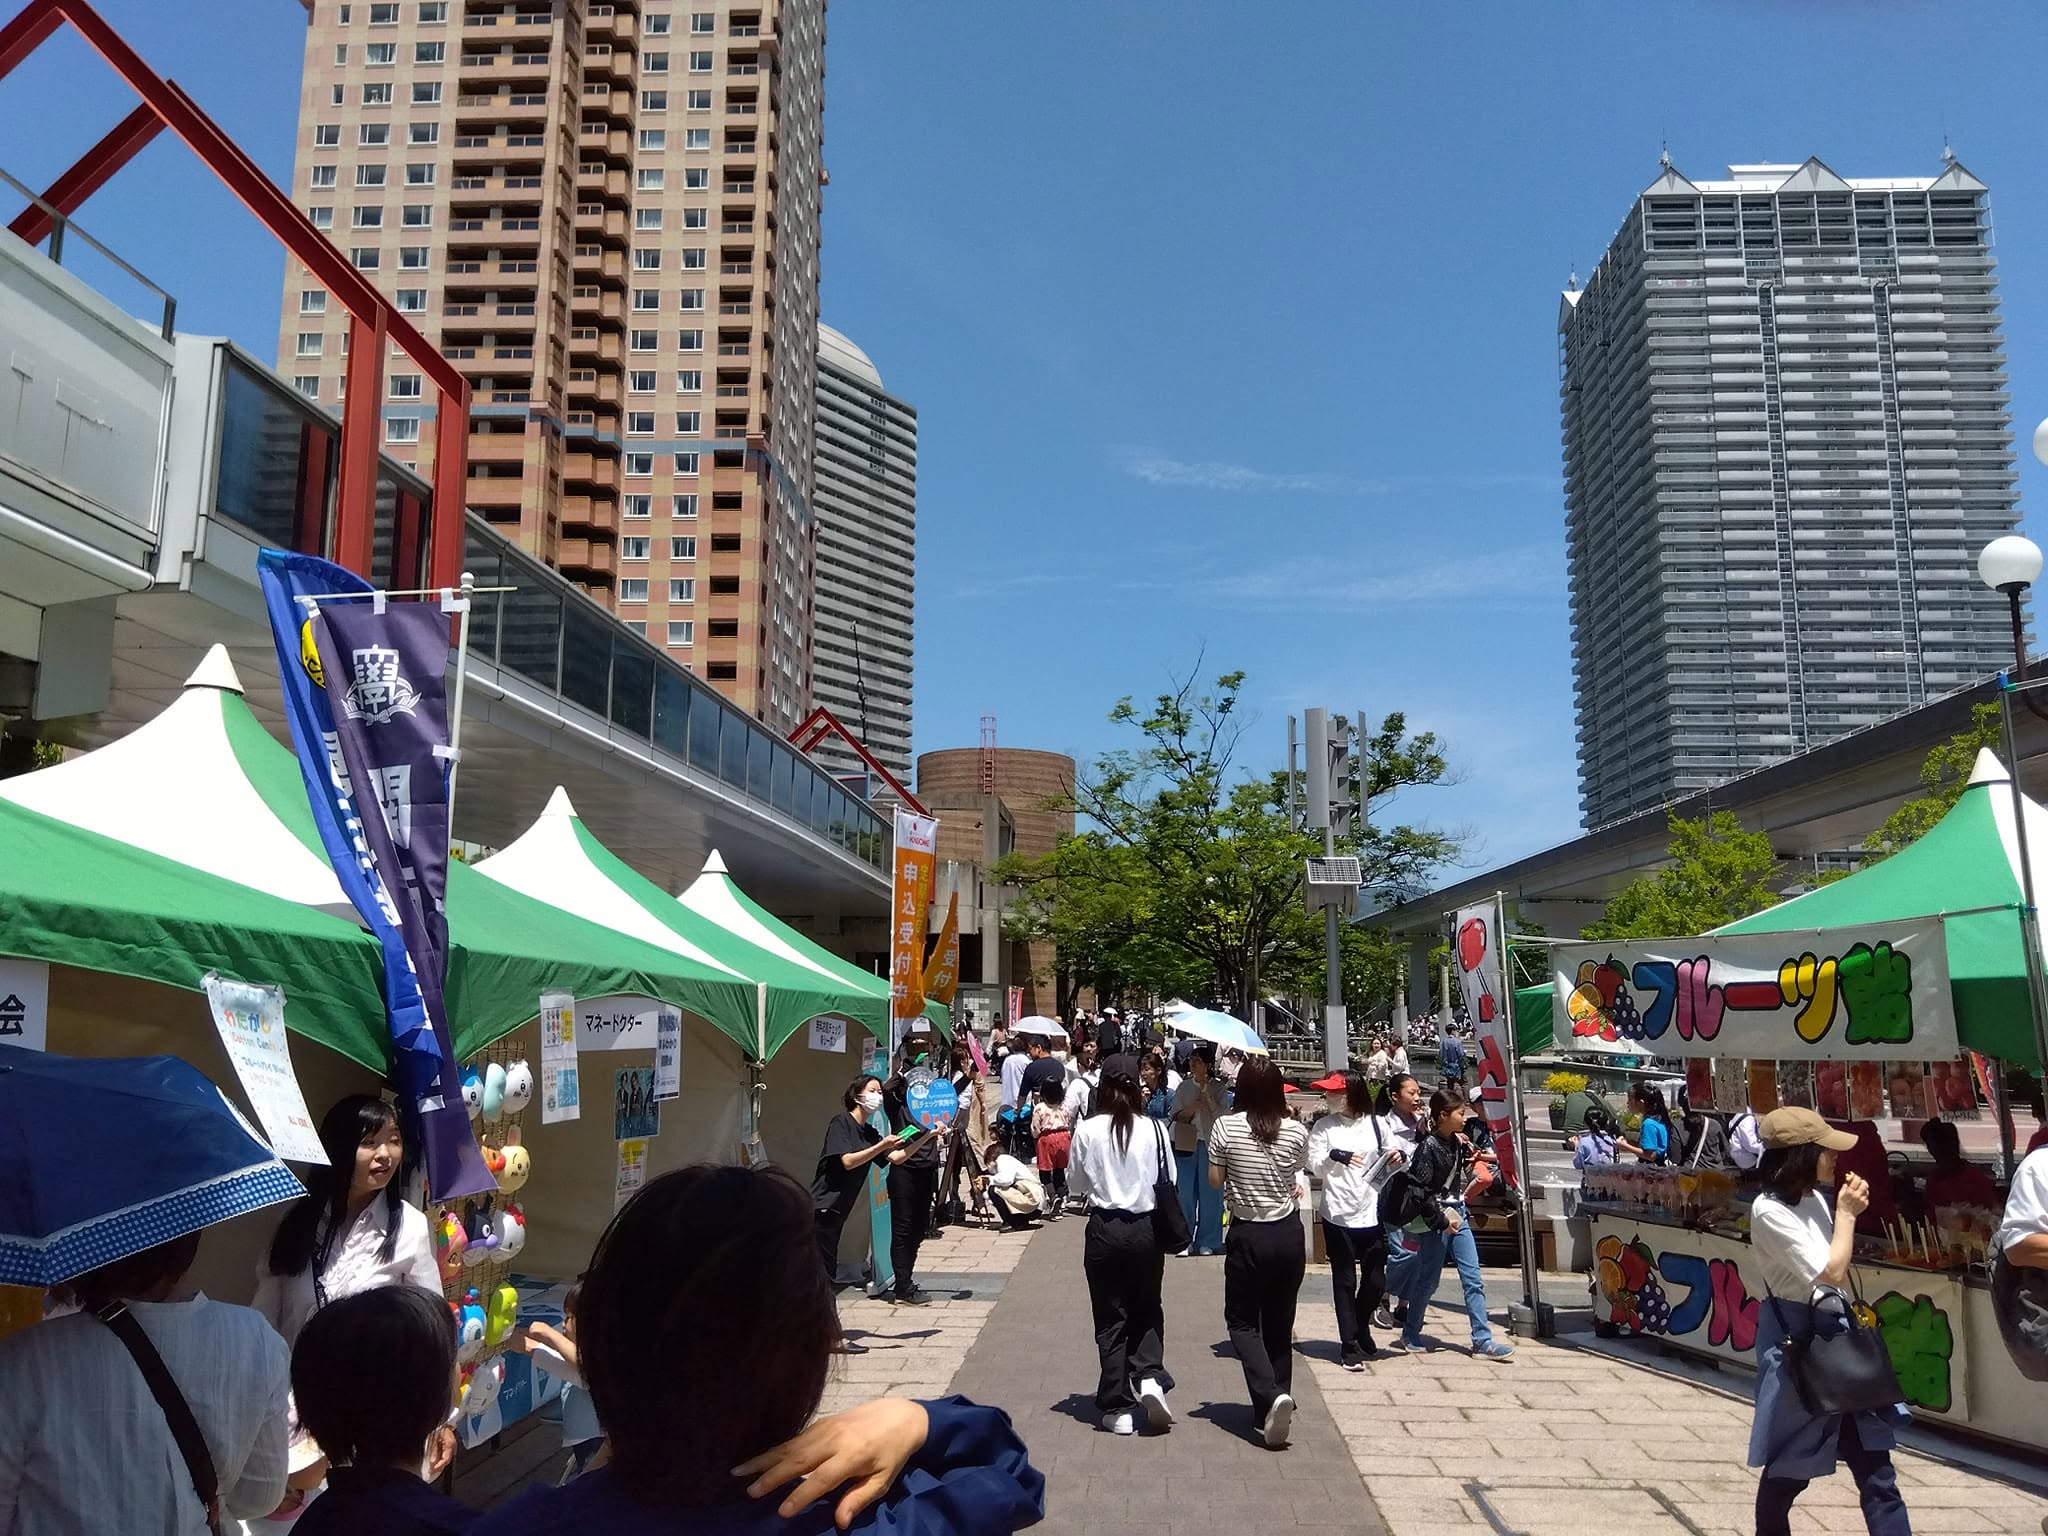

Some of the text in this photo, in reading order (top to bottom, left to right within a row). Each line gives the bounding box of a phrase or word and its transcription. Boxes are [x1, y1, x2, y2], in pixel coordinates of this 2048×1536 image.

[893, 861, 918, 1000] 申込受付中
[1632, 941, 1913, 1045] フルーツ飴
[0, 994, 26, 1036] 会
[224, 1008, 272, 1034] わたがし
[585, 1014, 642, 1033] マネードクター
